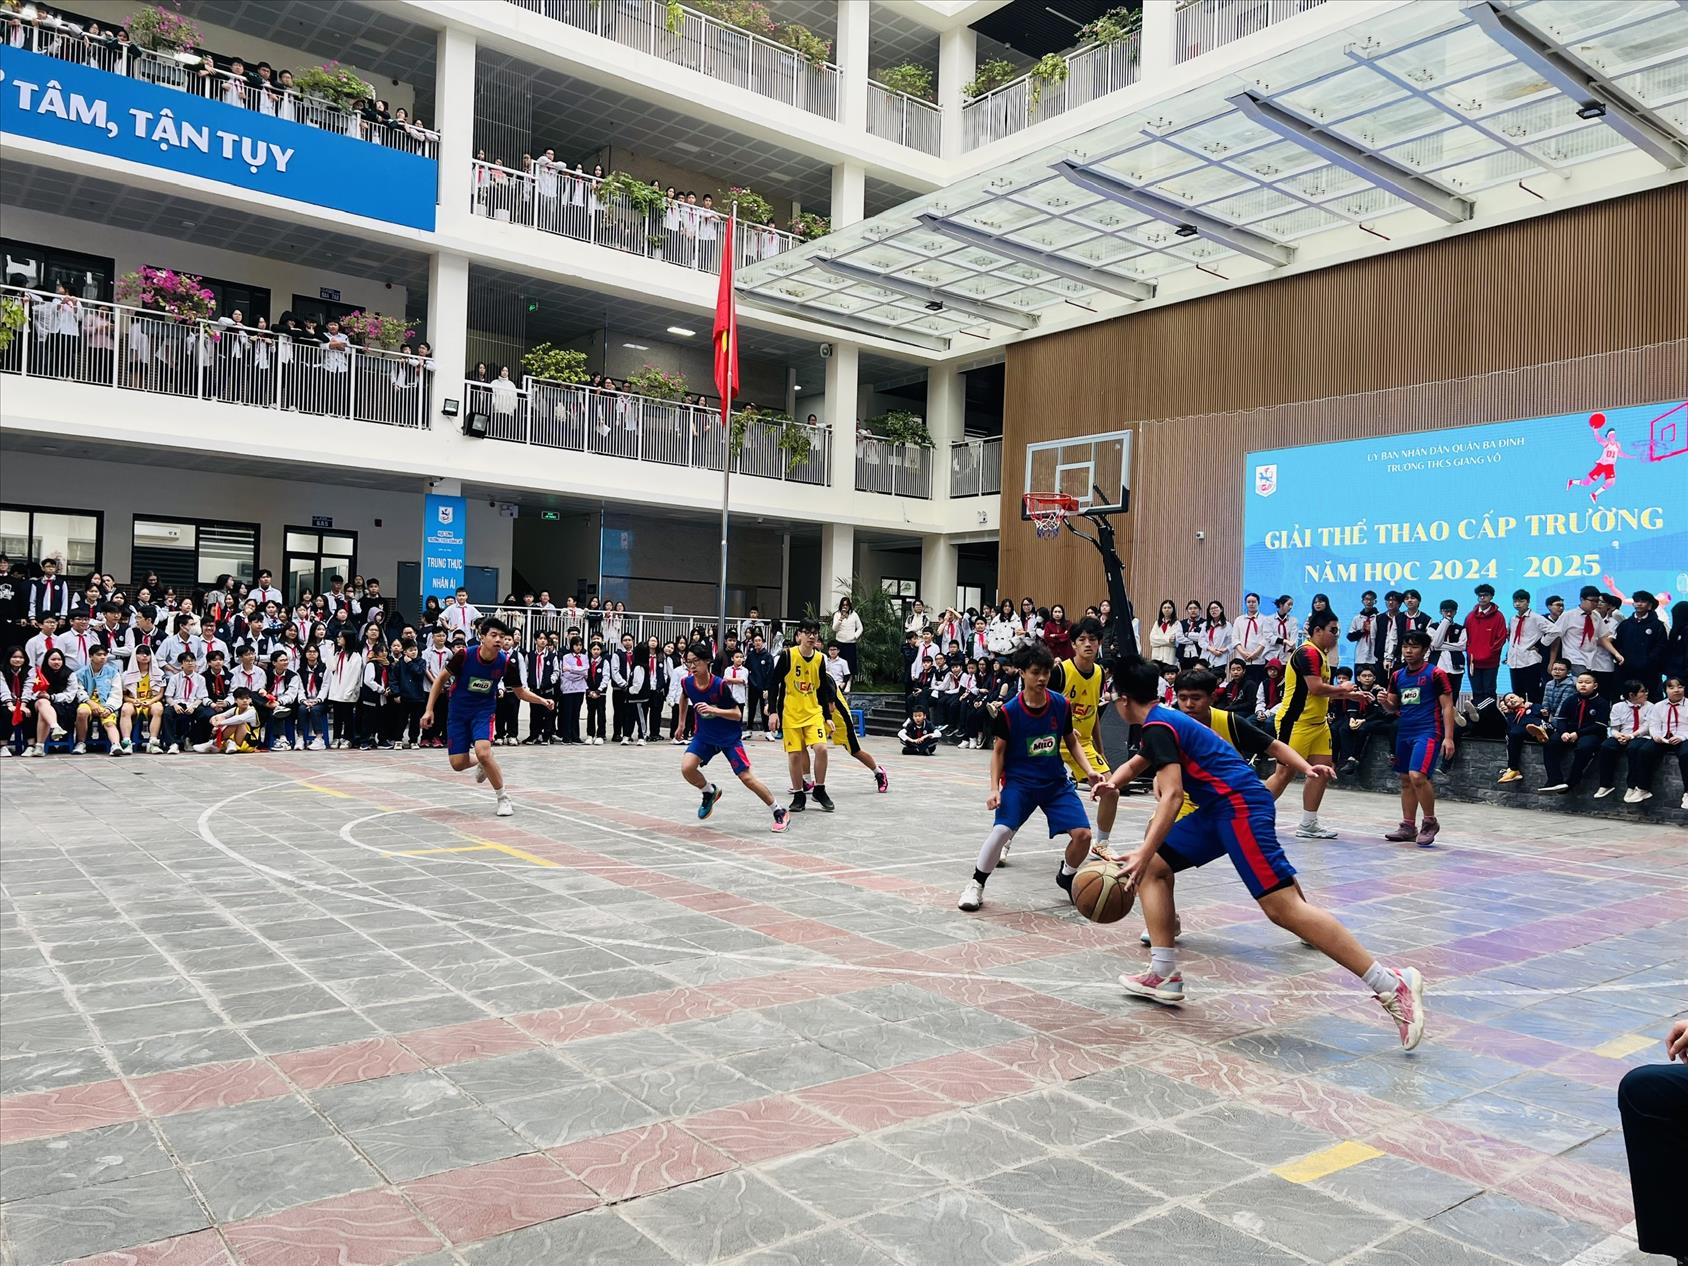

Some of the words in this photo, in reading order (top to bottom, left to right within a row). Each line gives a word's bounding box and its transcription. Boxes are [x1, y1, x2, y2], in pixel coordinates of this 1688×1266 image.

[12, 80, 119, 138] TÂM,
[129, 108, 209, 153] TẬN
[216, 130, 295, 174] TỤY
[1381, 451, 1399, 461] BAN
[1482, 440, 1496, 449] BA
[1427, 458, 1451, 469] THCS
[1264, 524, 1312, 550] GIẢI
[1318, 518, 1368, 547] THỂ
[1374, 520, 1450, 544] THAO
[1457, 509, 1517, 540] CẤP
[1525, 506, 1664, 537] TRƯỜNG
[427, 557, 447, 569] TRUNG
[1304, 560, 1358, 583] NĂM
[1364, 561, 1420, 586] HỌC
[1428, 558, 1498, 581] 2024
[1523, 554, 1601, 577] 2025
[432, 576, 448, 589] NHÂN
[796, 666, 801, 676] 5
[1069, 684, 1076, 698] 6
[817, 729, 823, 738] 5
[1033, 741, 1053, 750] MILO
